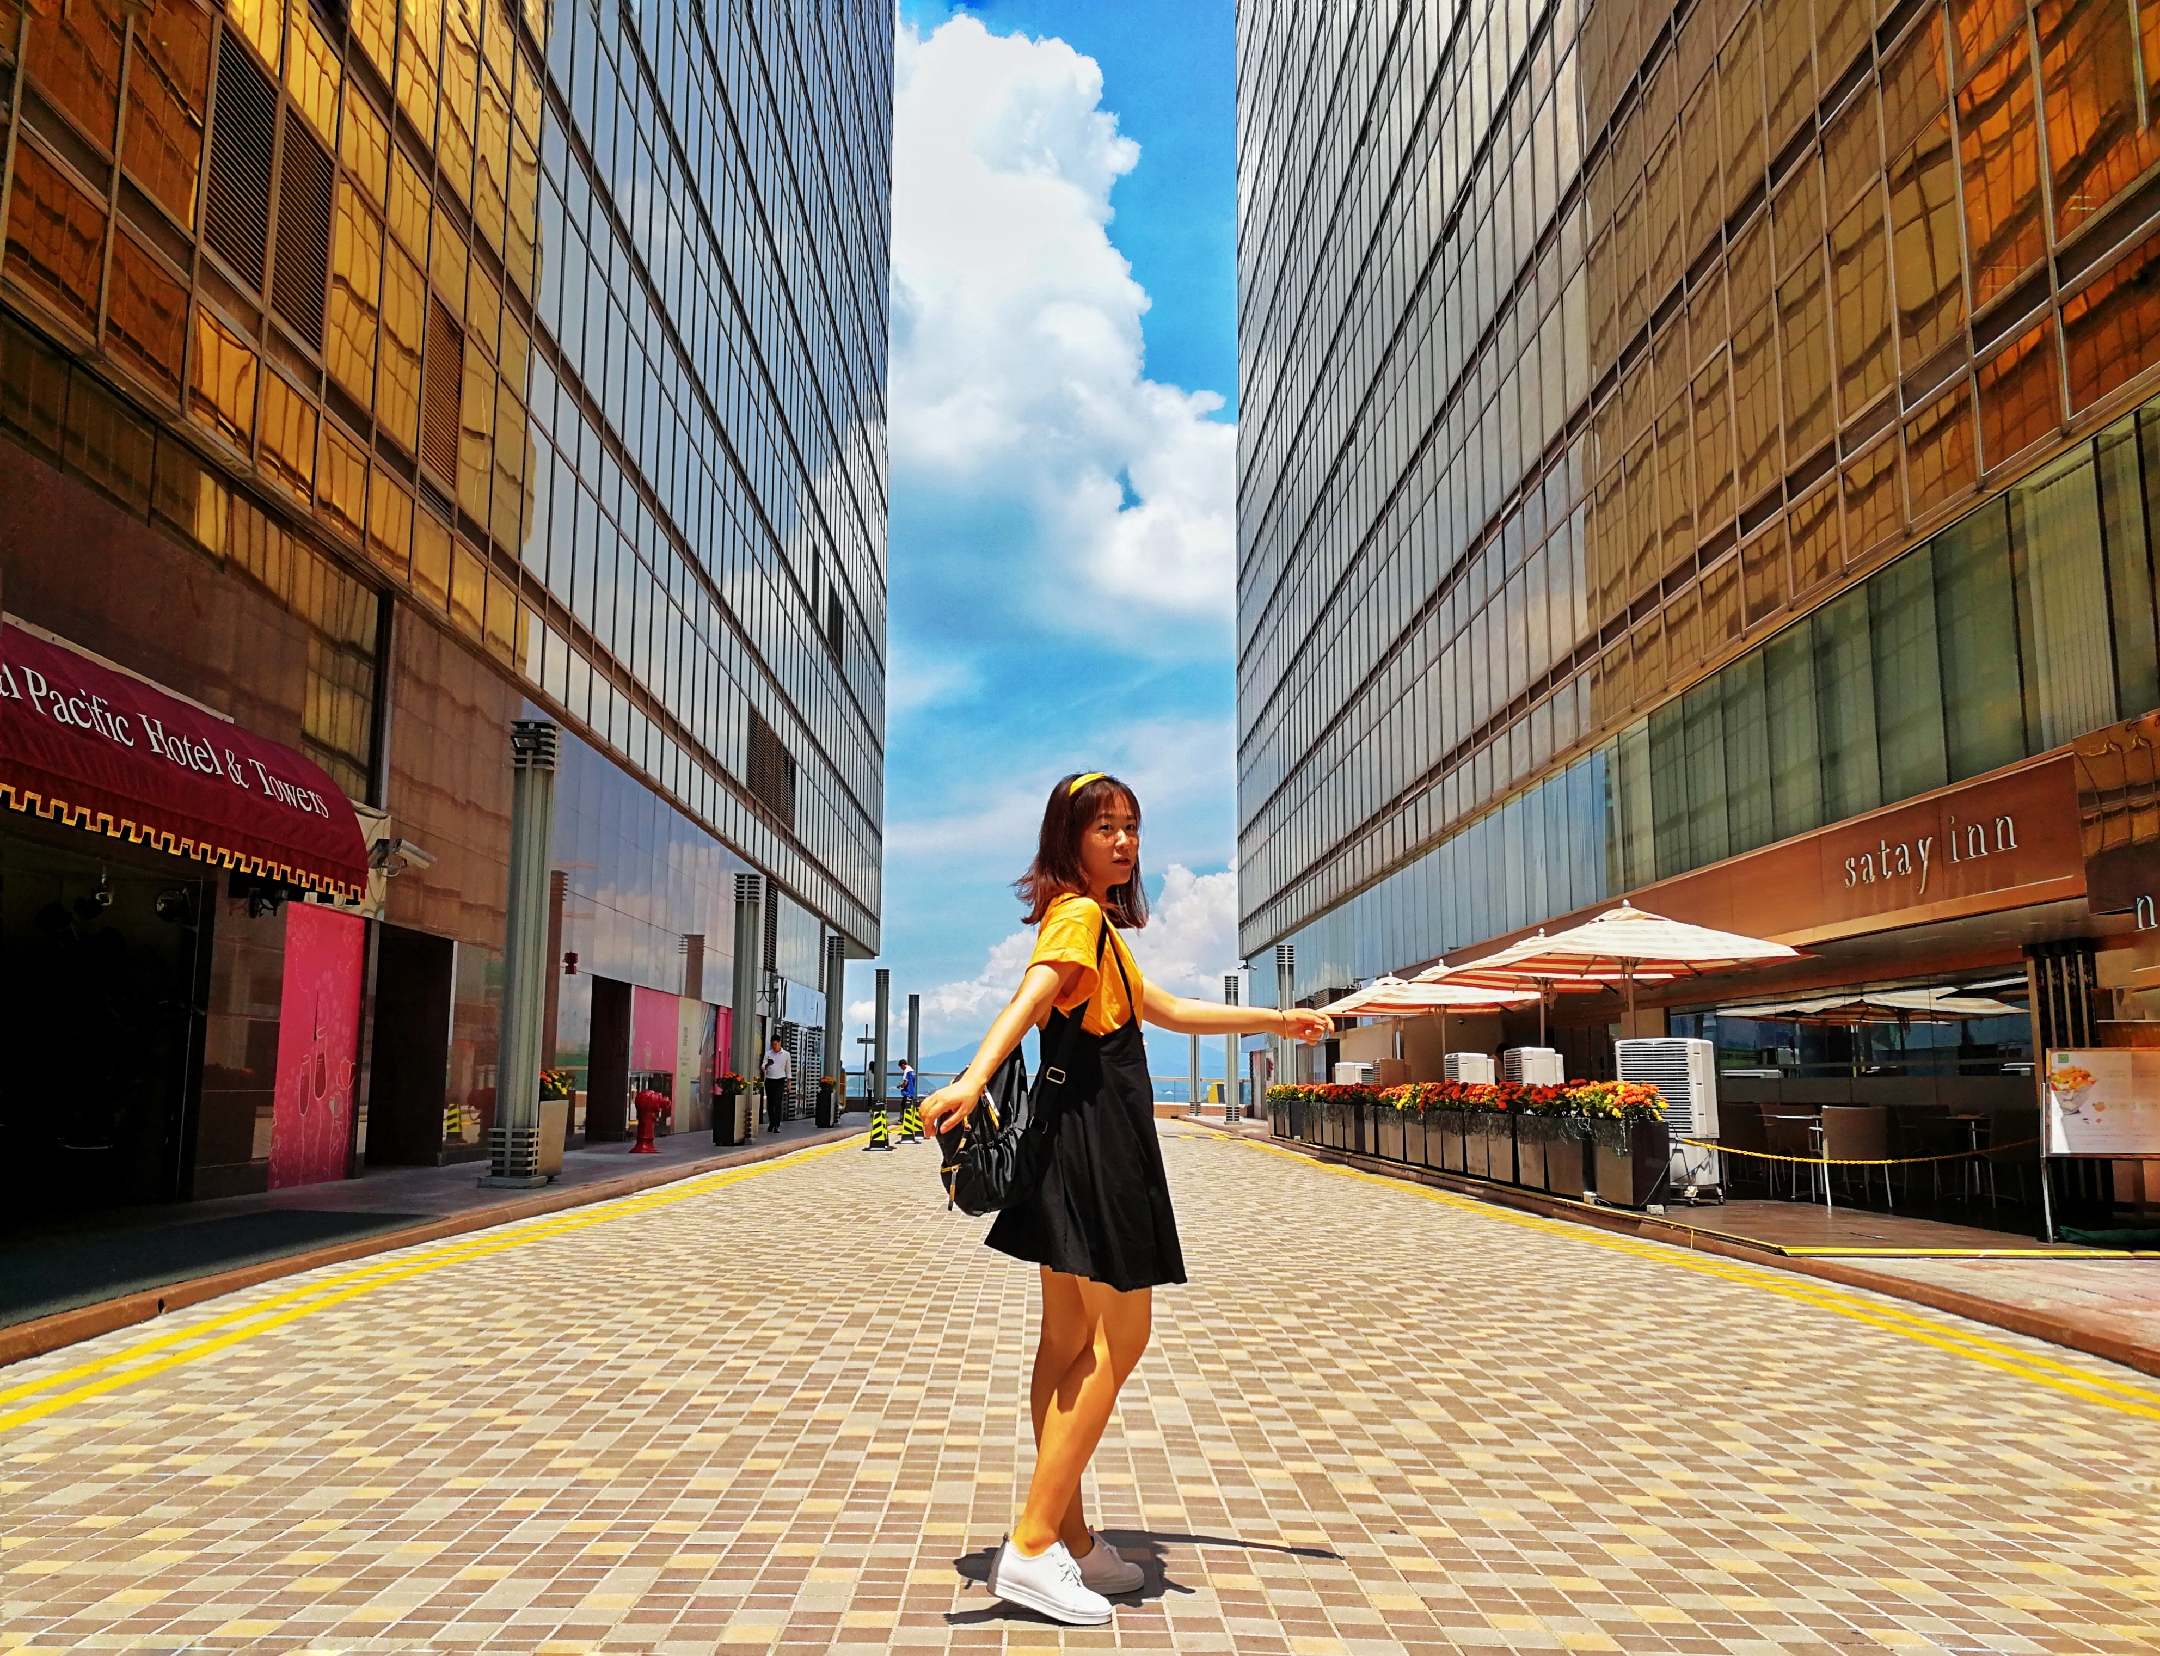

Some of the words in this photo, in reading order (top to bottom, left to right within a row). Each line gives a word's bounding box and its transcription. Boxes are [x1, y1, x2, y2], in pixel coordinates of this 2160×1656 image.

[20, 665, 134, 747] Pacific
[136, 712, 224, 776] Hotel
[225, 748, 249, 789] &
[247, 757, 329, 819] Towers
[1844, 836, 1932, 894] satay
[1949, 815, 2018, 863] inn
